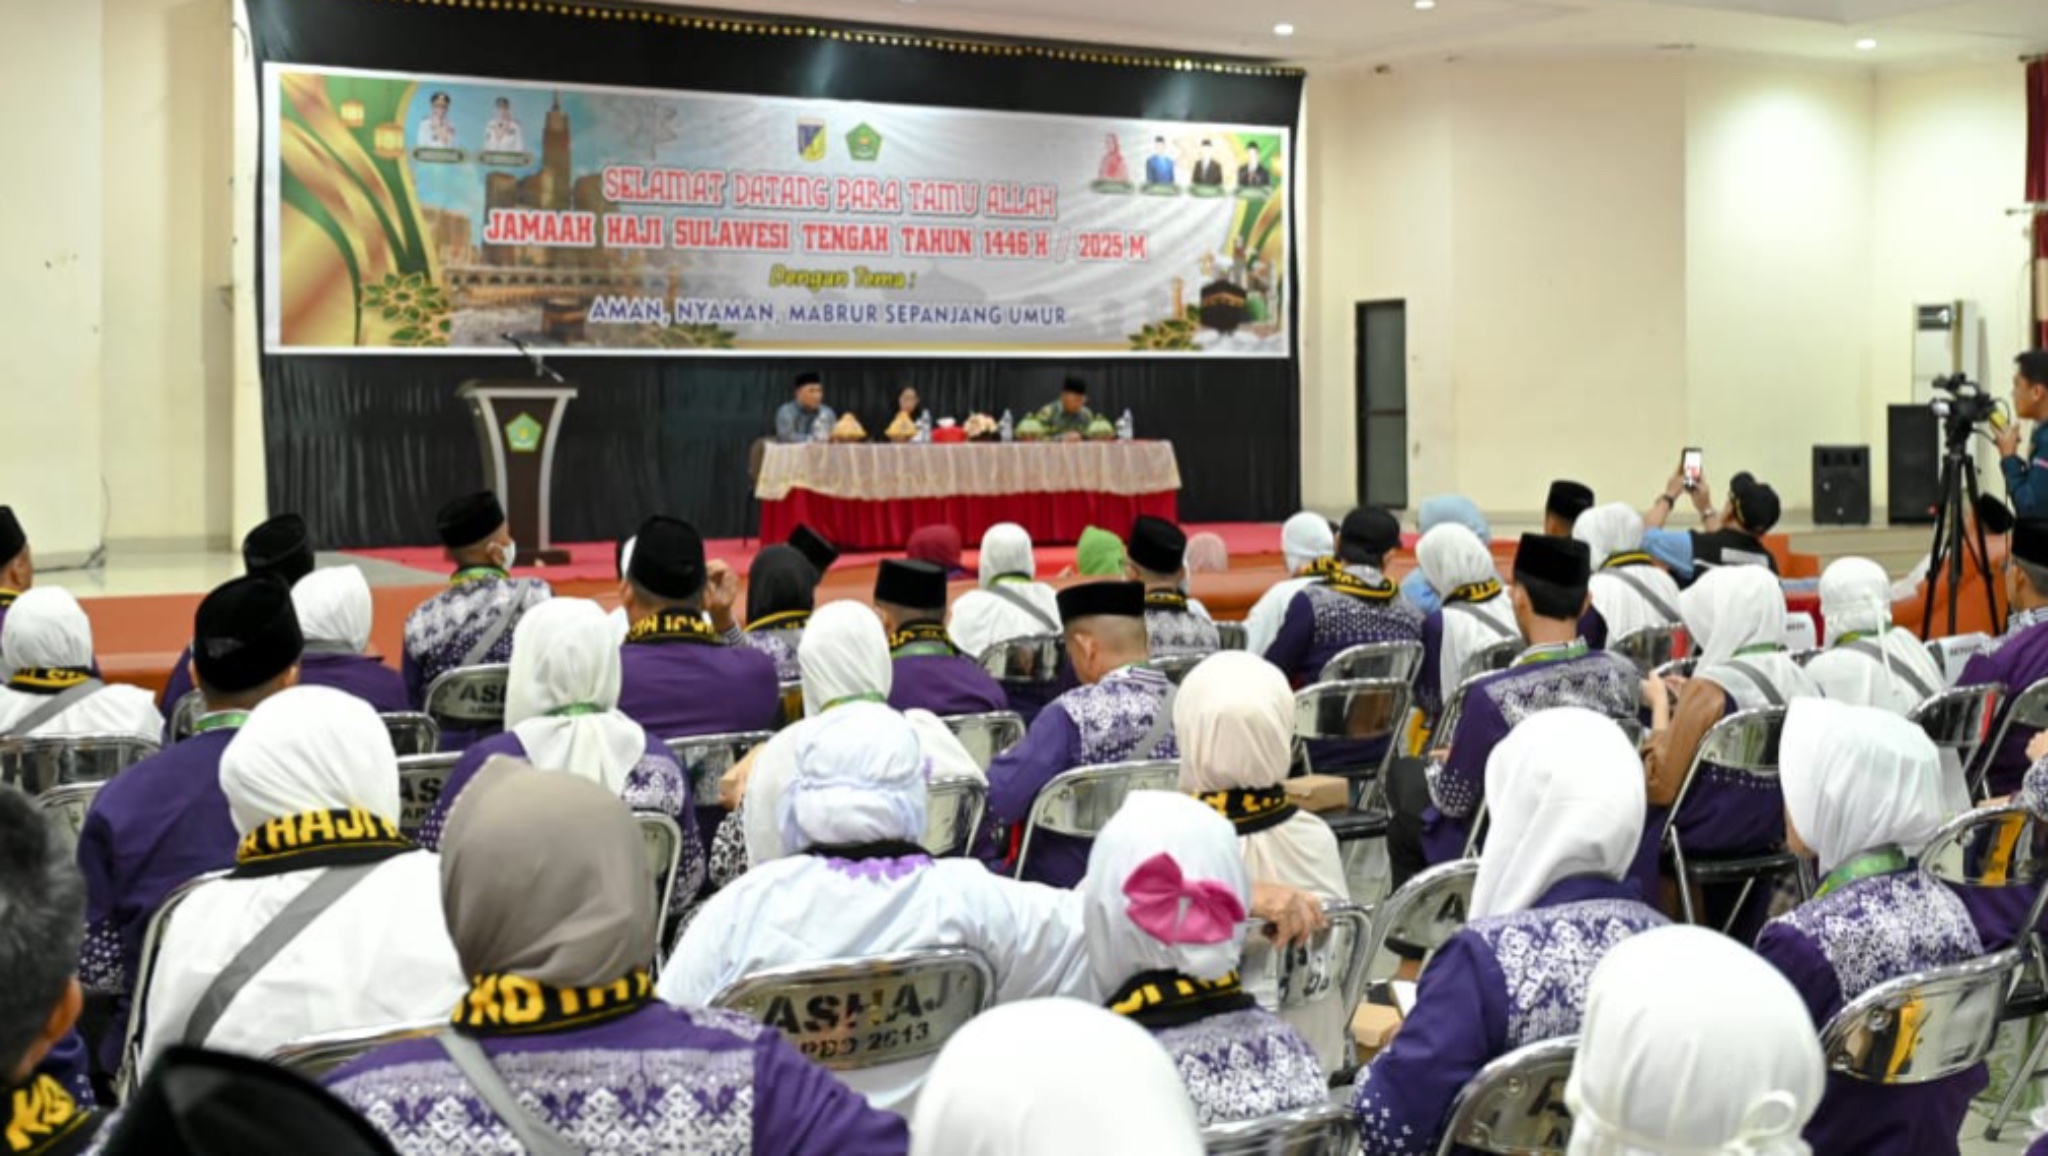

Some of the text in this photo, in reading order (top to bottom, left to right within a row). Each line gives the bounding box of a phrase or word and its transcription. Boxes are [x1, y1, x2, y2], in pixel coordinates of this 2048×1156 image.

[604, 168, 1056, 216] SELAMAT DATANG PARA TAMU ALLAH
[486, 212, 594, 244] JAMAAH
[606, 216, 662, 246] HAJI
[674, 218, 790, 249] SULAWESI
[801, 223, 889, 252] TENGAH
[900, 226, 973, 255] TAHUN
[983, 230, 1029, 256] 1446
[1034, 231, 1049, 257] H
[1078, 232, 1124, 259] 2025
[1129, 234, 1147, 260] M
[769, 263, 849, 294] Dengan
[591, 300, 1067, 327] AMAN, NYAMAN, MABRUR SEPANJANG UMUR
[264, 806, 379, 847] HAJI
